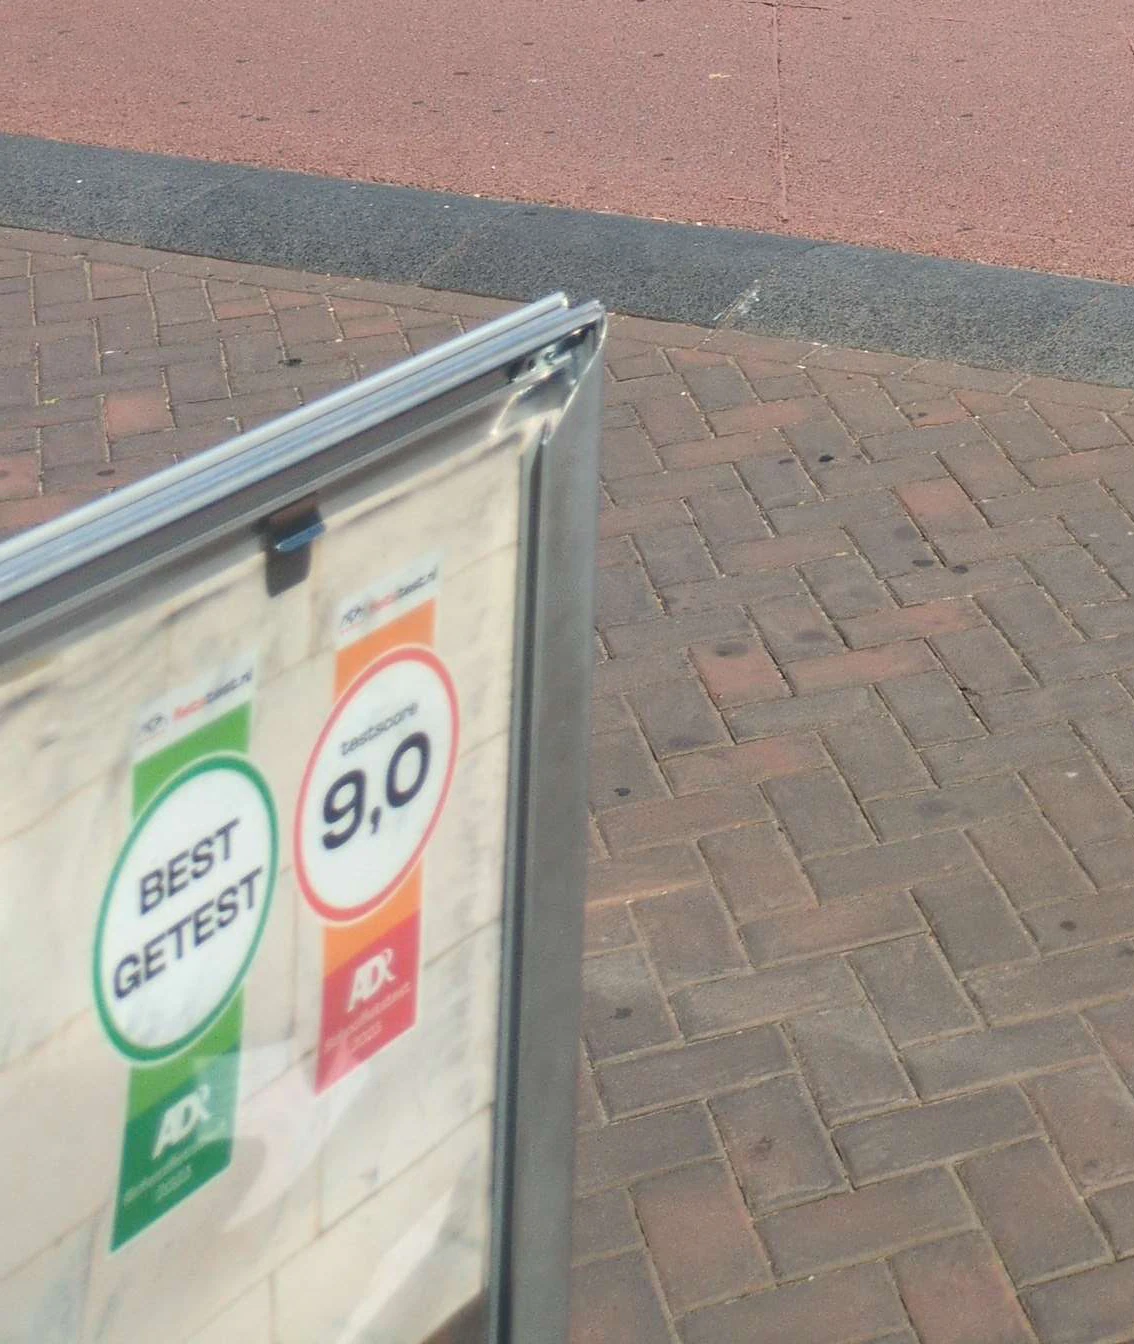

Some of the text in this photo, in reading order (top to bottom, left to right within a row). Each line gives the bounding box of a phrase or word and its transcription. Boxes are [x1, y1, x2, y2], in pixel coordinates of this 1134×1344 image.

[341, 702, 419, 757] testscore
[322, 731, 431, 851] 9,0
[139, 818, 240, 916] BEST
[113, 866, 263, 1001] GETEST
